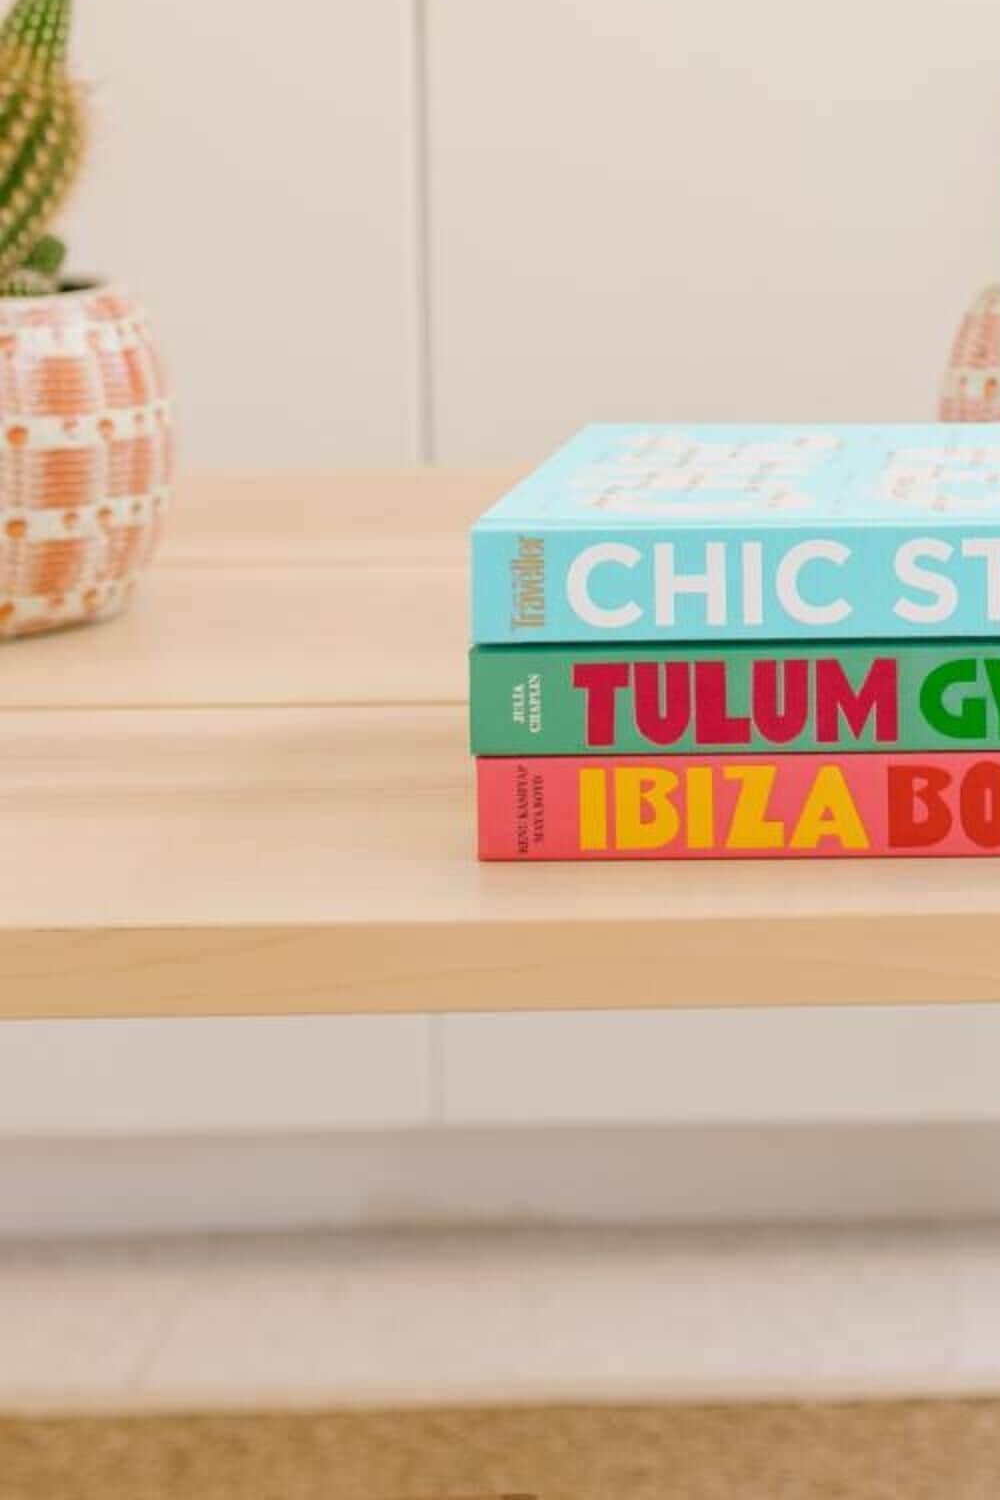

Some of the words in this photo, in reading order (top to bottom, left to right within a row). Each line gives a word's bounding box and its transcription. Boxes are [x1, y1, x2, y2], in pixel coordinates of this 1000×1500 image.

[565, 539, 854, 628] CHIC
[572, 657, 898, 747] TULUM
[579, 765, 870, 852] IBIZA
